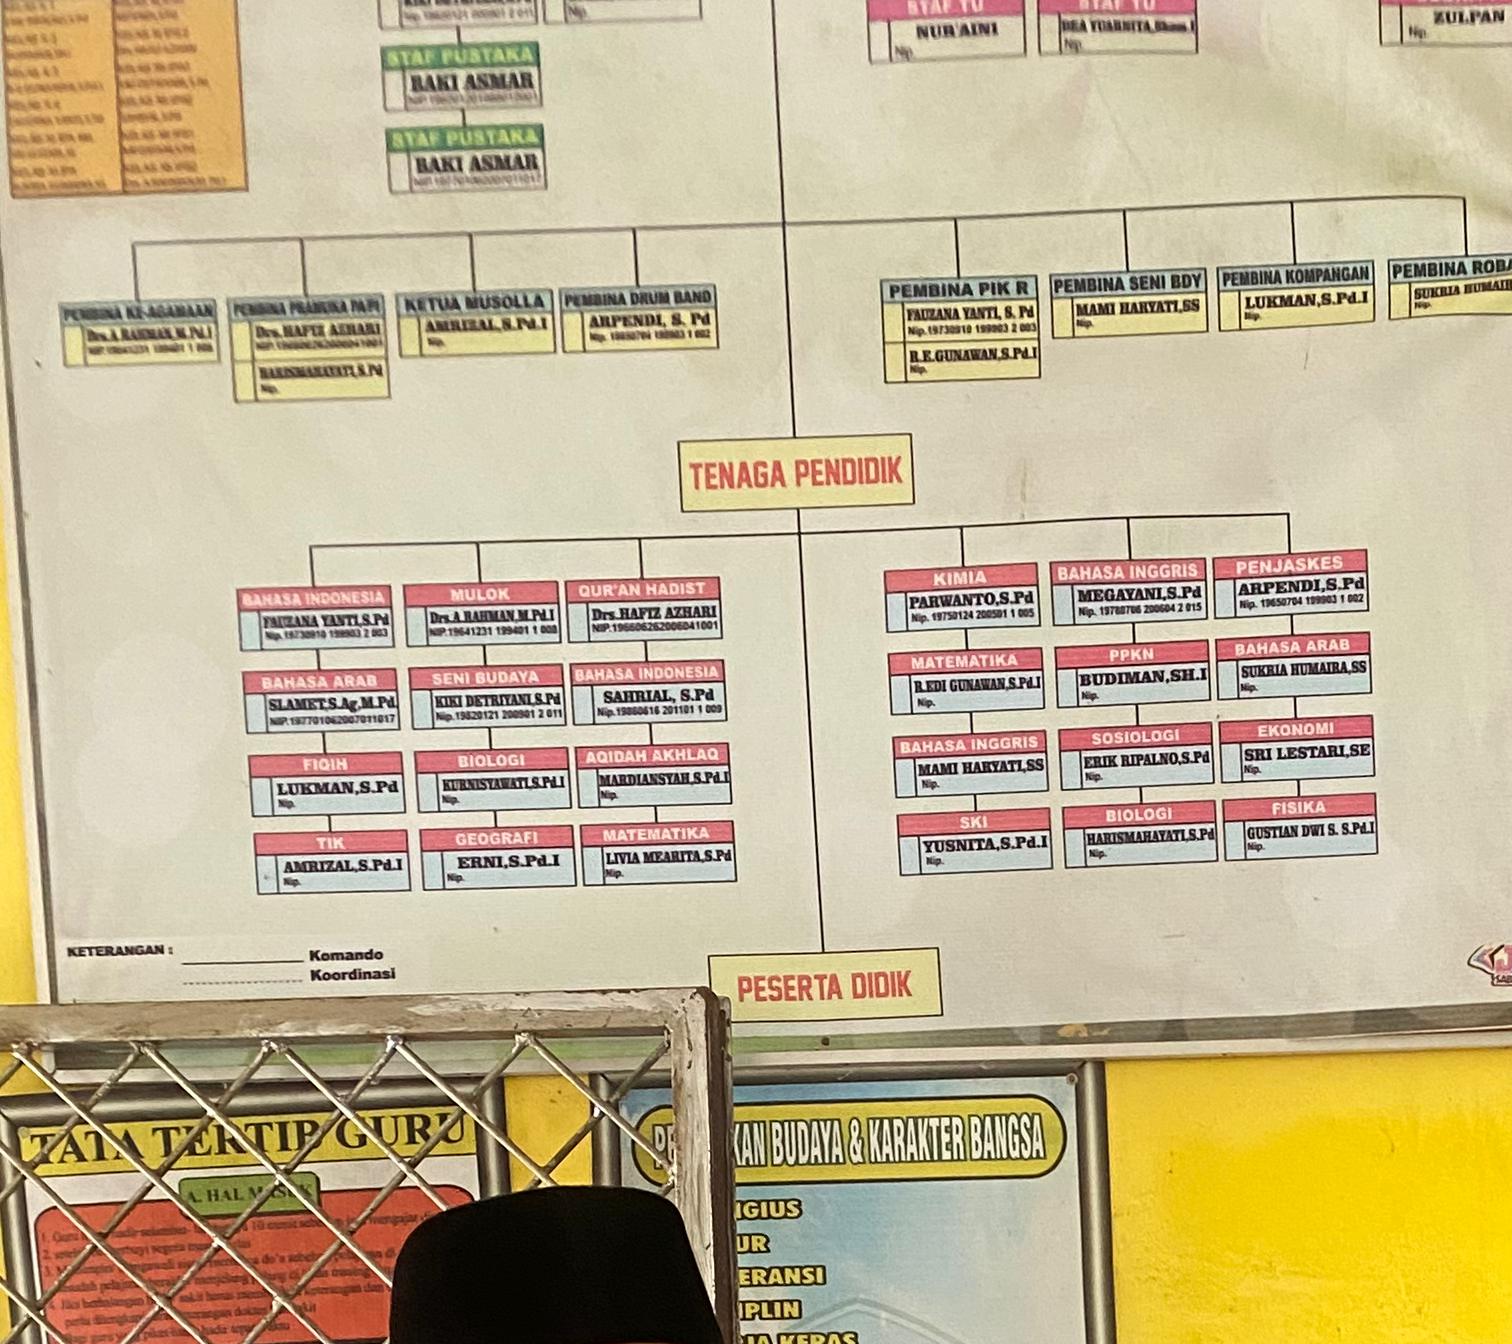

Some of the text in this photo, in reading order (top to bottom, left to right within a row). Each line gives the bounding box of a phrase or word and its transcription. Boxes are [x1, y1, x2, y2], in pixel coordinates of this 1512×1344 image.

[387, 46, 534, 64] STAF PUSTAKA
[1222, 266, 1369, 286] PEMBINA KOMPANGAN
[1392, 261, 1467, 279] PEMBINA
[889, 281, 1028, 299] PEMBINA PIK R
[1054, 272, 1201, 294] PEMBINA SENI BDY
[690, 456, 903, 490] TENAGA PENDIDIK
[1236, 556, 1343, 575] PENJASKES
[934, 570, 987, 586] KIMIA
[451, 588, 510, 600] MULOK
[579, 582, 706, 597] QUR'AN HADIST
[1238, 577, 1364, 596] ARPENDI,S.Pd
[912, 654, 1018, 669] MATEMATIKA
[1109, 648, 1153, 661] PPKN
[432, 671, 539, 685] SENI BUDAYA
[1080, 668, 1207, 686] BUDIMAN,SH.I
[1092, 730, 1179, 745] SOSIOLOGI
[1258, 723, 1334, 737] EKONOMI
[1245, 744, 1370, 761] SRI LESTARI,SE
[303, 759, 347, 770] FIQIH
[458, 755, 524, 767] BIOLOGI
[277, 781, 397, 796] LUKMAN,S.Pd
[1272, 801, 1325, 815] FISIKA
[960, 816, 987, 829] SKI
[317, 837, 345, 850] TIK
[455, 832, 538, 845] GEOGRAFI
[67, 945, 164, 957] KETERANGAN
[309, 948, 384, 962] Komando
[310, 967, 396, 982] Koordinasi
[738, 970, 912, 1002] PESERTA DIDIK
[30, 1129, 142, 1165] TATA
[335, 1112, 466, 1149] GURU
[771, 1120, 845, 1166] BUDAYA
[848, 1119, 864, 1165] &
[869, 1115, 965, 1163] KARAKTER
[970, 1113, 1046, 1161] BANGSA
